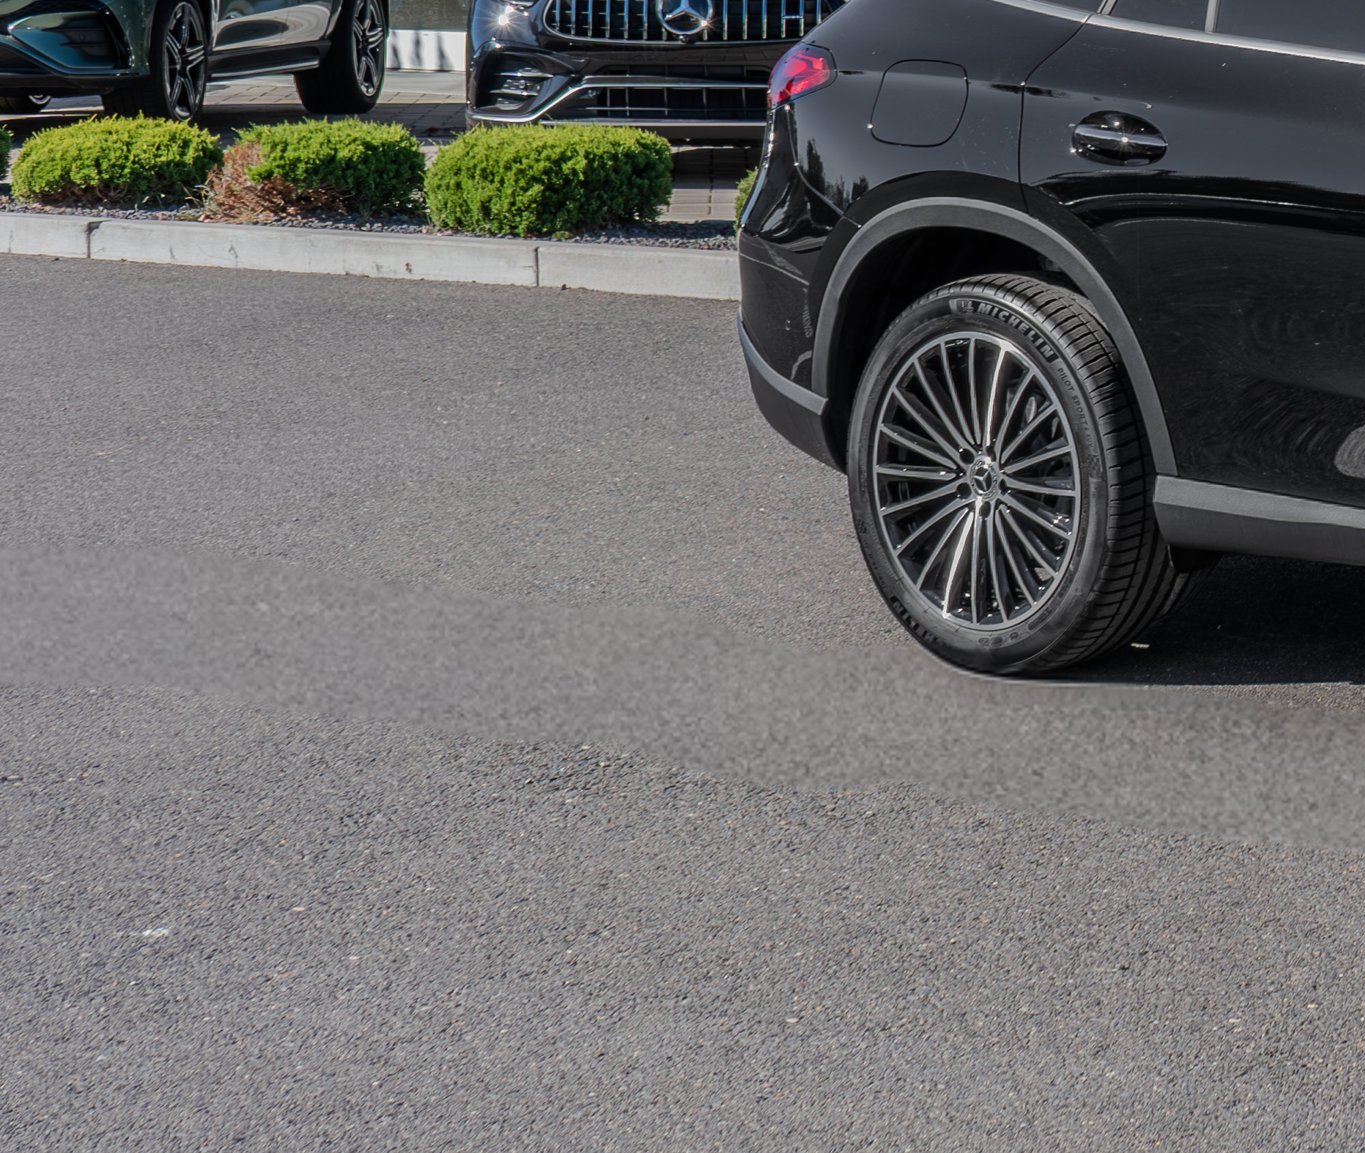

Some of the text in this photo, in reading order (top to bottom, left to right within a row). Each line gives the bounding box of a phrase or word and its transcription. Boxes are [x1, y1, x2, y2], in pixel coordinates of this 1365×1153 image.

[976, 301, 1054, 360] MICHELIN
[1057, 367, 1075, 391] PILOT
[1071, 395, 1089, 426] SPORT
